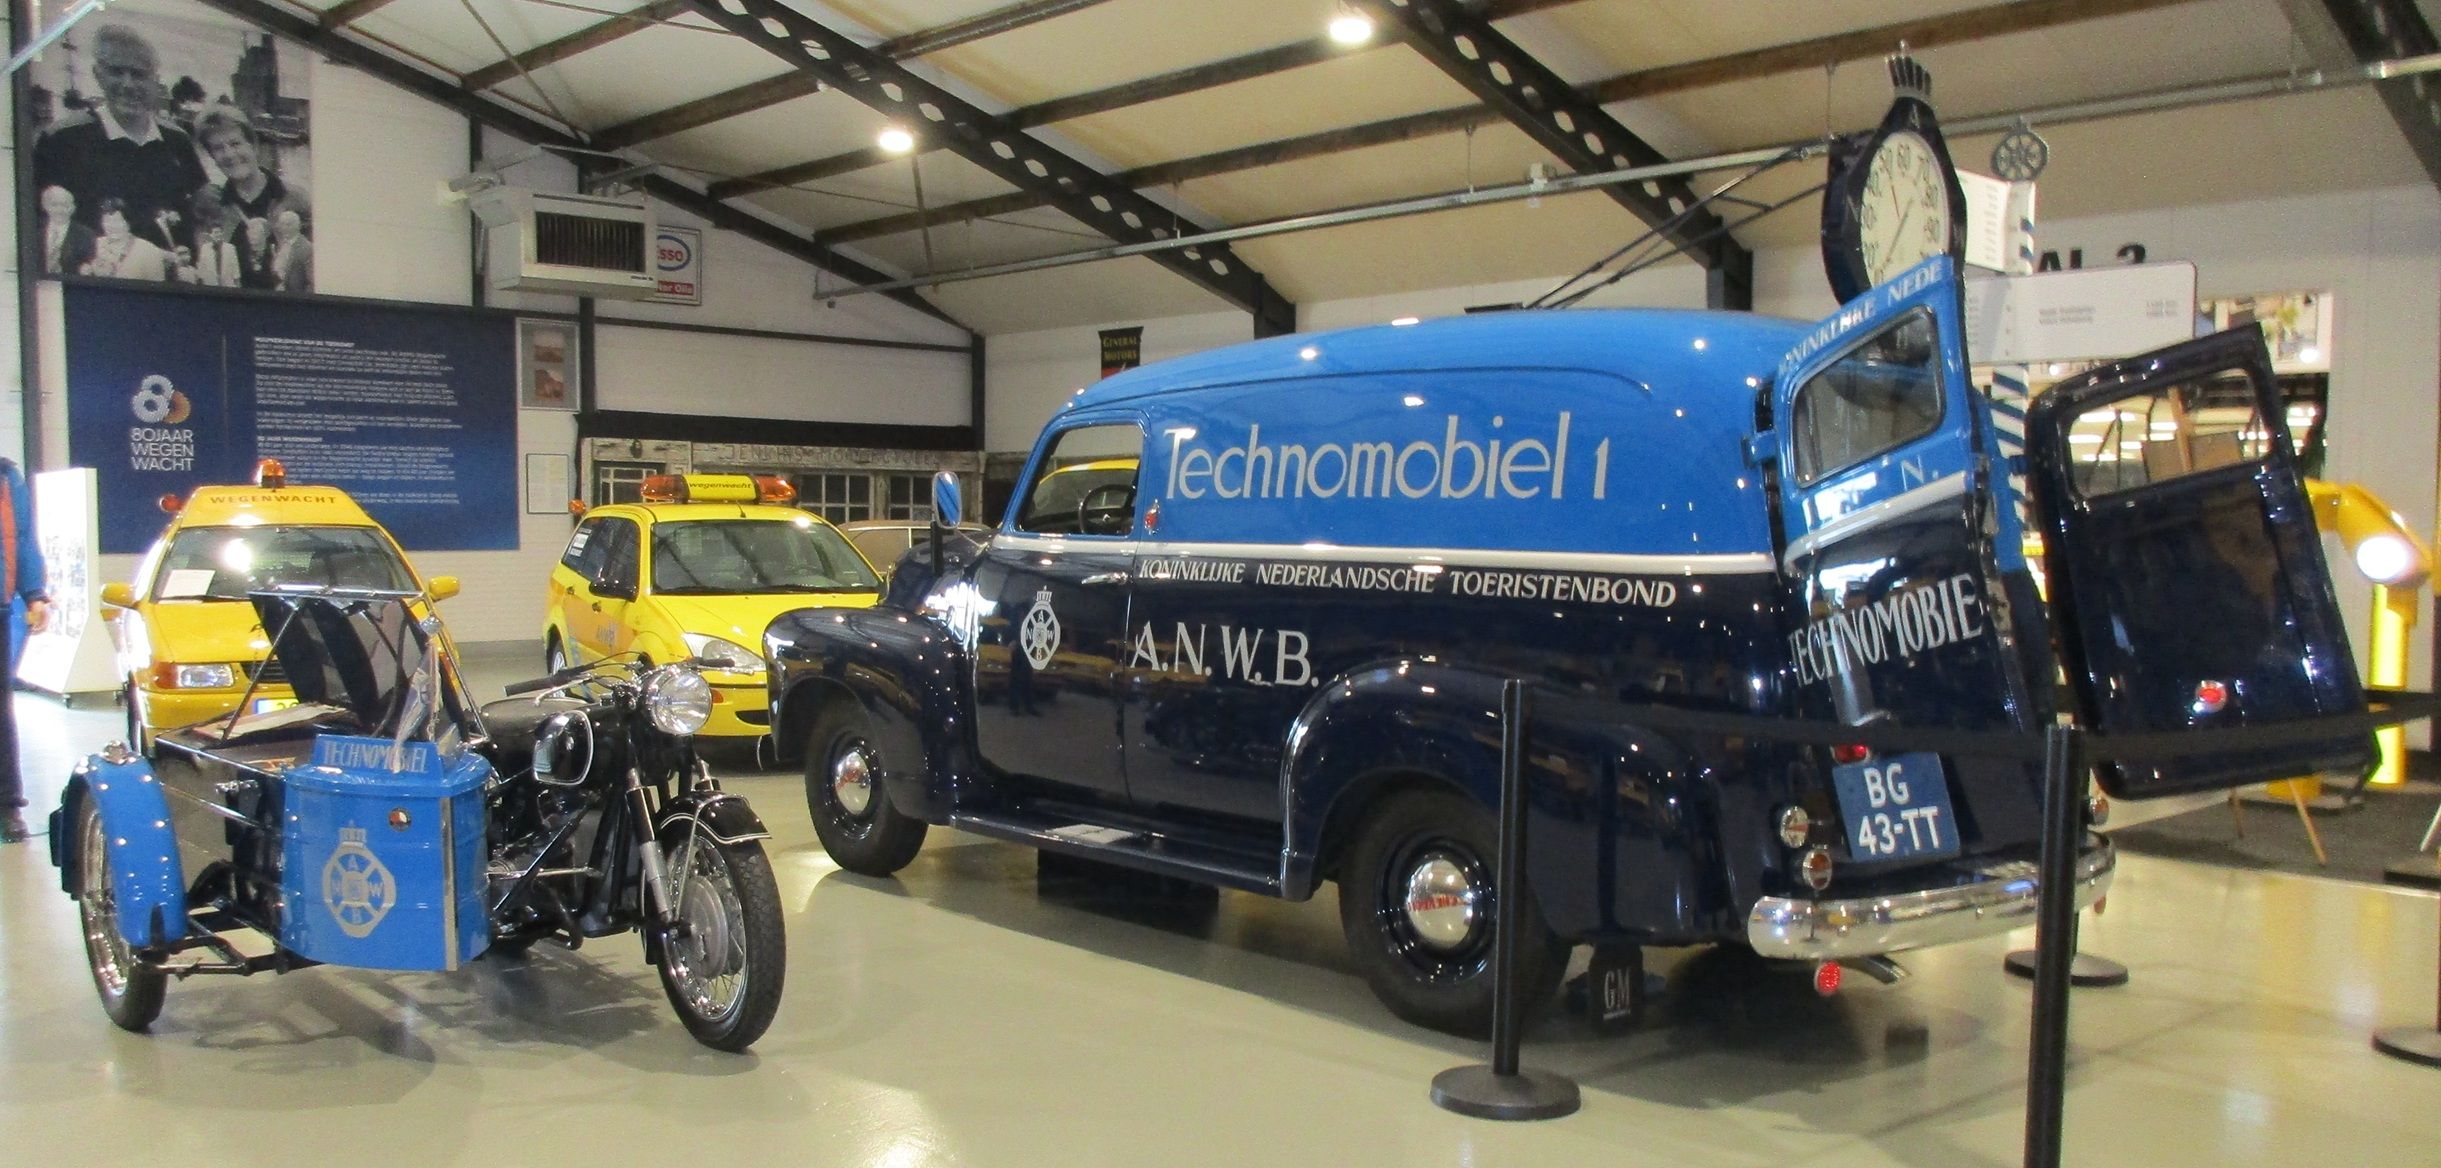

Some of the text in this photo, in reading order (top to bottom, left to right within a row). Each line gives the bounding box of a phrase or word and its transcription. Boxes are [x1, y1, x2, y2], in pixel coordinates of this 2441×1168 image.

[1103, 335, 1138, 348] GENERAL
[1103, 350, 1138, 361] MOTORS
[130, 442, 195, 457] WEGEN
[130, 456, 195, 472] WACHT
[1163, 411, 1610, 500] Technomobiel 1
[210, 494, 337, 504] WEGENWACHT
[1138, 560, 1677, 608] KONINKLIJKE NEDERLANDSCHE TOERISTENBOND
[1130, 619, 1320, 687] A.N.W.B.
[1863, 762, 1910, 809] BG
[1858, 805, 1940, 855] 43-TT
[1604, 967, 1630, 1010] GM
